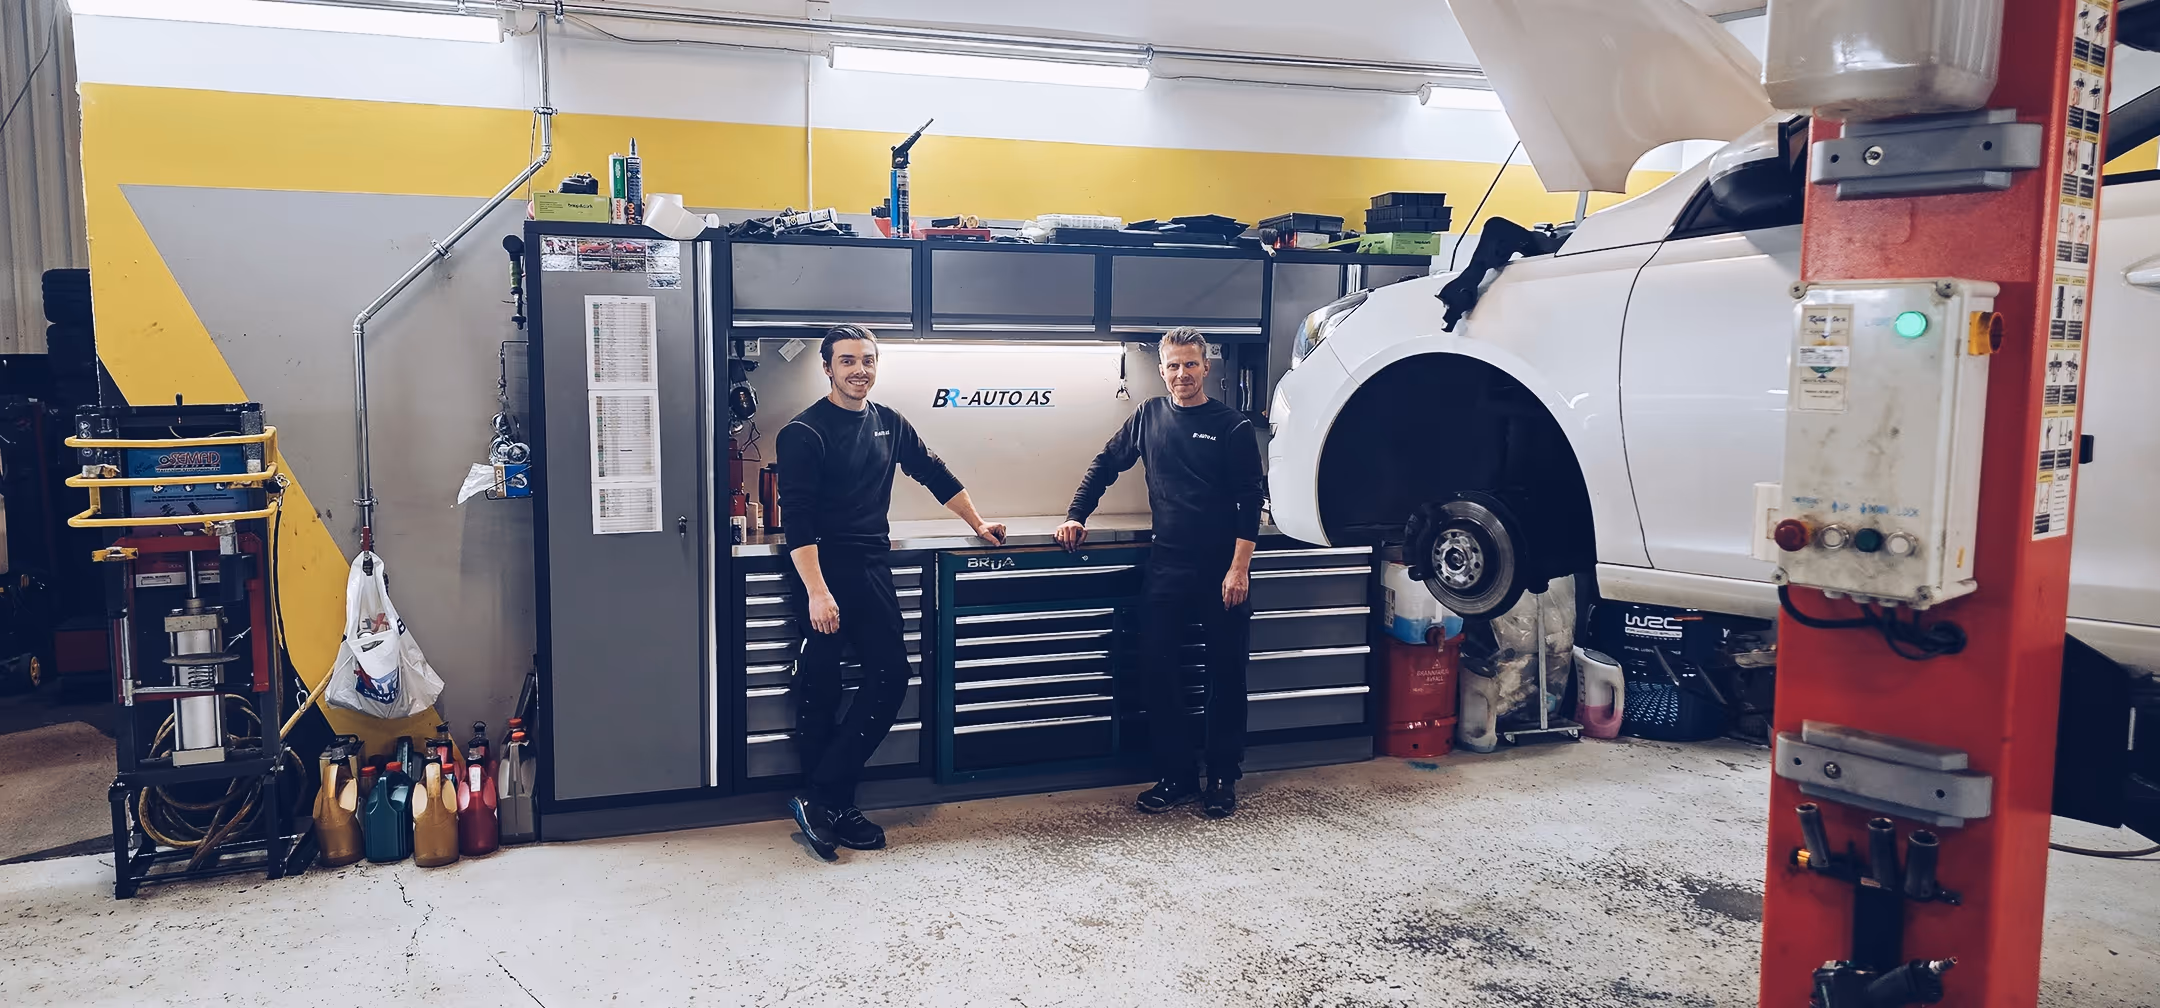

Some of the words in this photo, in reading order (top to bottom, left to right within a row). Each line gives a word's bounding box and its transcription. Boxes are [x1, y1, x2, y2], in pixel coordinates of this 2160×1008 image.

[932, 388, 1022, 408] BR-AUTO
[1026, 390, 1052, 406] AS
[967, 556, 1016, 570] BRUA
[1625, 612, 1683, 630] WRC
